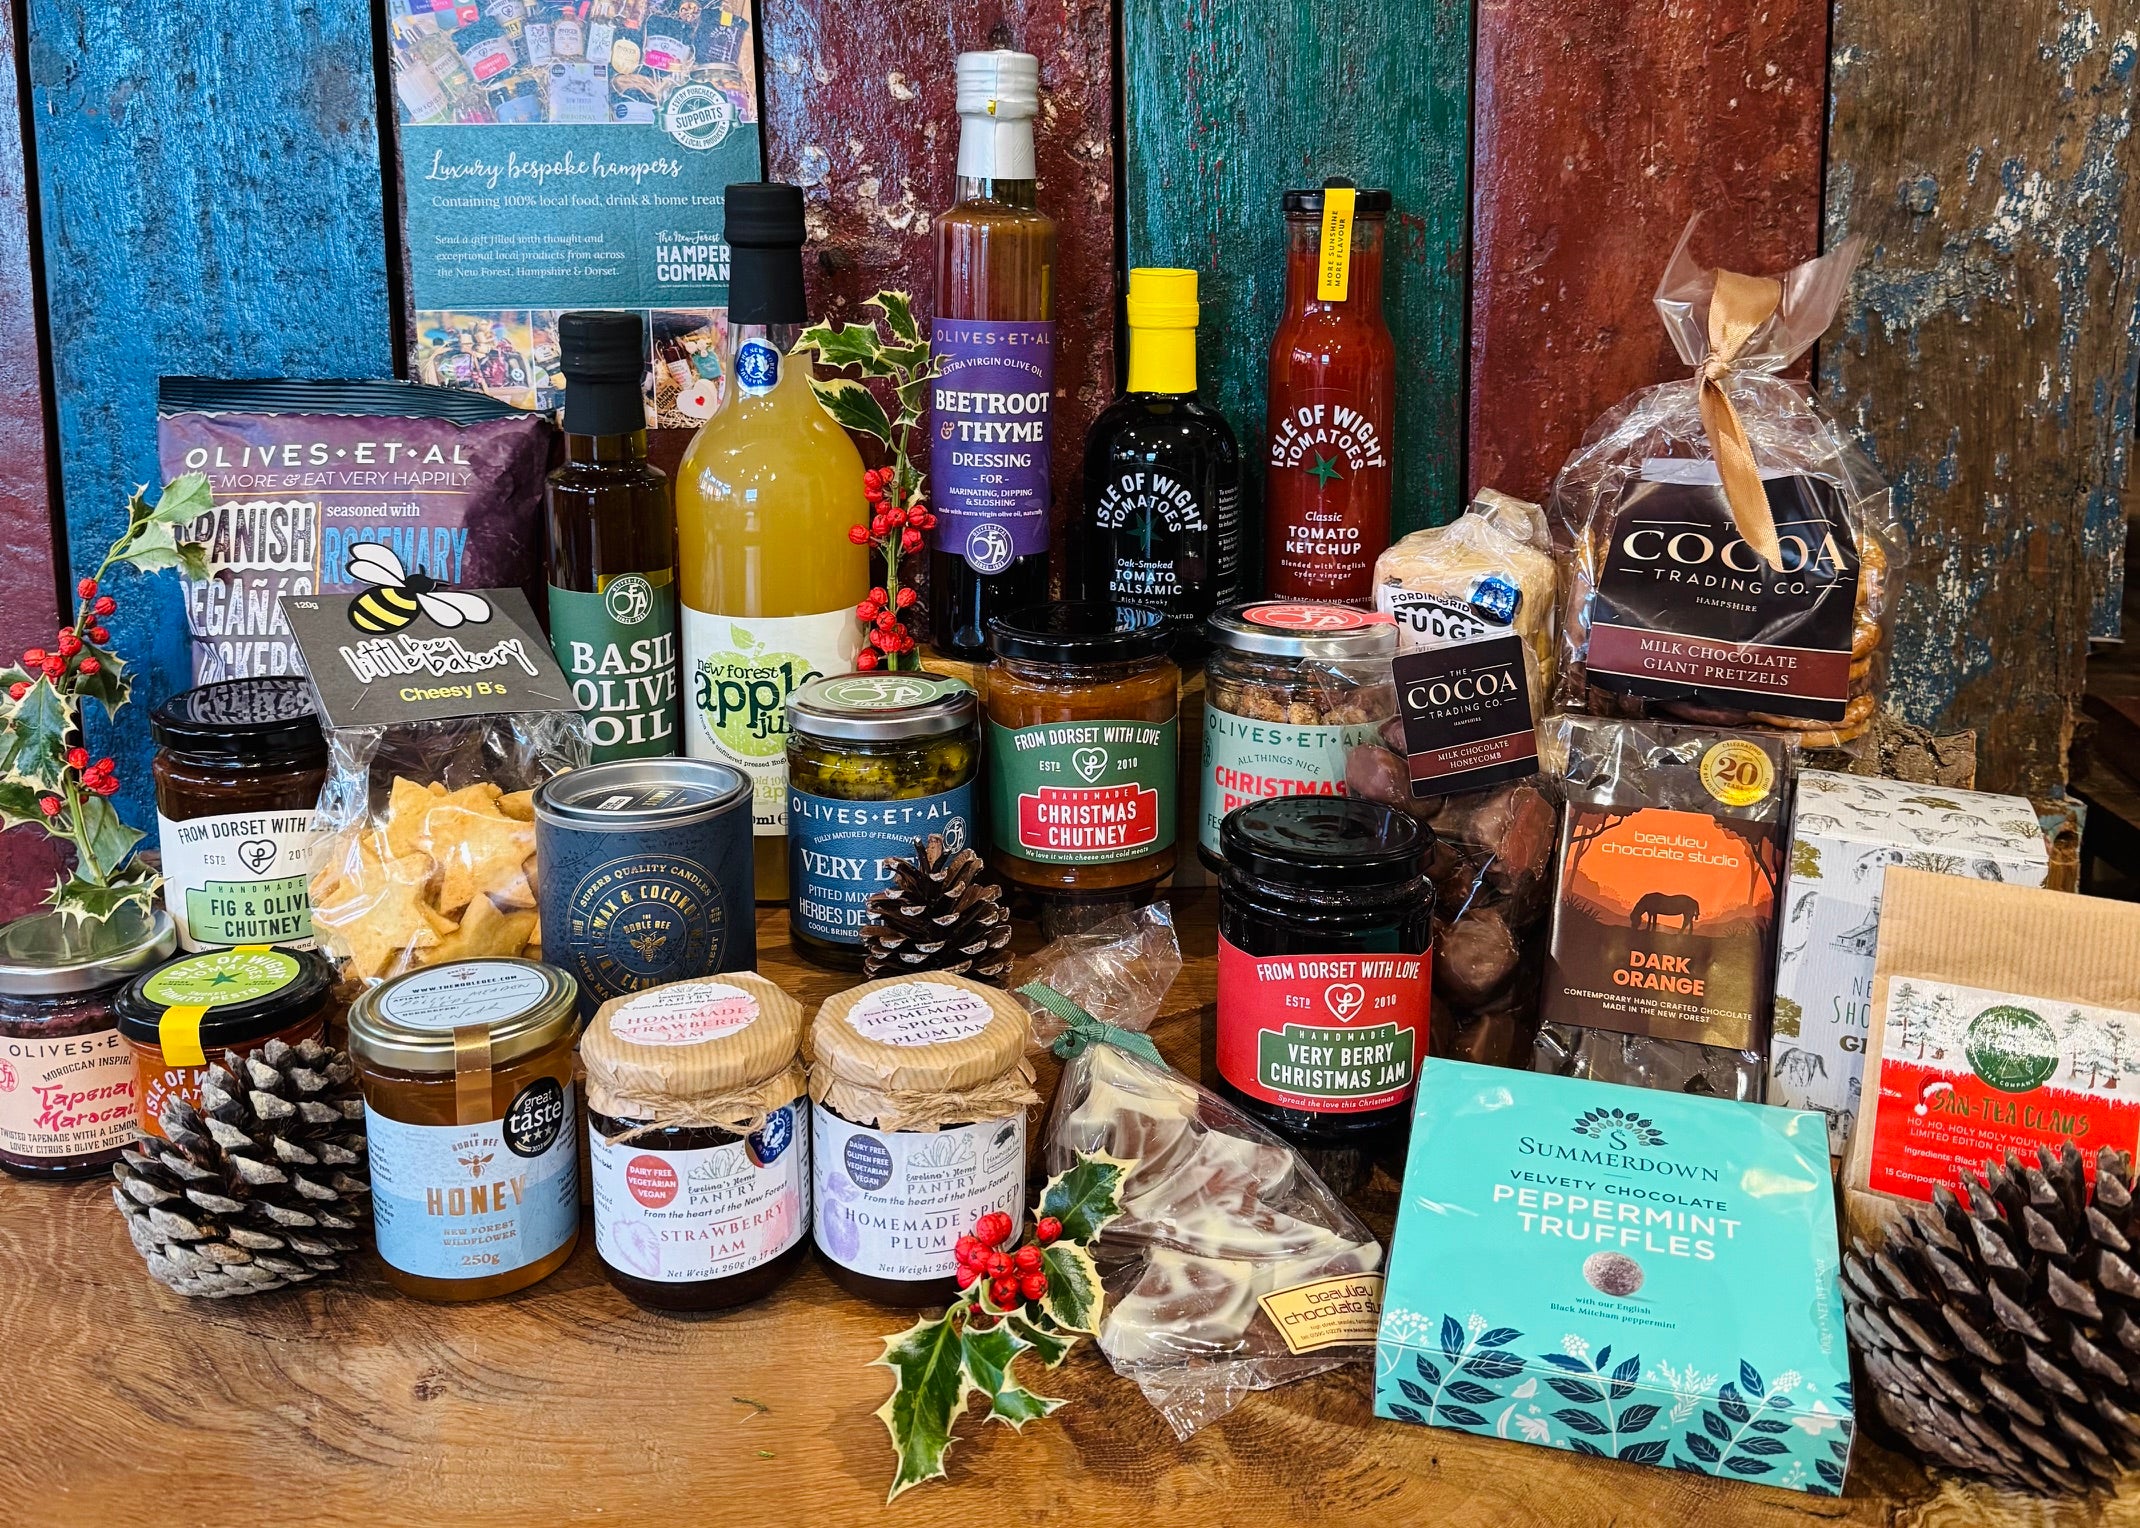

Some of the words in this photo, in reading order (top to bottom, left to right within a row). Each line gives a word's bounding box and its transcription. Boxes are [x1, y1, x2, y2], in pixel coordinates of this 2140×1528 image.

[676, 107, 723, 129] SUPPORTS
[426, 150, 504, 189] Luxury
[508, 151, 589, 185] bespoke
[592, 152, 682, 184] hampers
[432, 196, 500, 208] Containing
[504, 196, 536, 206] 100%
[540, 194, 570, 206] local
[572, 194, 603, 207] food,
[606, 194, 638, 206] drink
[642, 195, 650, 206] &
[654, 194, 688, 206] home
[692, 196, 725, 205] treats
[1329, 210, 1338, 257] SUNSHINE
[1337, 218, 1346, 258] FLAVOUR
[436, 251, 492, 261] exceptional
[496, 251, 519, 260] local
[522, 251, 564, 262] products
[567, 250, 592, 260] from
[595, 251, 625, 259] across
[657, 246, 731, 262] HAMPER
[658, 264, 731, 281] COMPAN
[936, 390, 1049, 415] BEETROOT
[940, 421, 954, 441] &
[958, 421, 1043, 442] THYME
[952, 452, 1031, 468] DRESSING
[221, 473, 277, 489] MORE
[283, 472, 301, 487] &
[304, 472, 334, 485] EAT
[340, 471, 390, 486] VERY
[394, 472, 472, 486] HAPPILY
[950, 487, 1000, 498] MARINATING,
[1001, 489, 1032, 497] DIPPING
[327, 505, 388, 517] seasoned
[390, 502, 420, 517] with
[1305, 511, 1343, 522] Classic
[1289, 525, 1359, 539] TOMATO
[1286, 541, 1361, 555] KETCHUP
[1622, 530, 1849, 574] COCOA
[1117, 558, 1173, 569] Oak-Smoked
[1281, 560, 1311, 568] Blended
[1336, 562, 1366, 571] English
[1115, 569, 1176, 582] TOMATO
[1110, 582, 1183, 595] BALSAMIC
[294, 602, 319, 611] 120g
[570, 632, 675, 675] BASIL
[1639, 638, 1683, 656] MILK
[1687, 644, 1798, 669] CHOCOLATE
[697, 659, 725, 677] new
[727, 665, 779, 679] forest
[1643, 657, 1700, 675] GIANT
[1704, 666, 1789, 686] PRETZELS
[400, 684, 472, 702] Cheesy
[572, 666, 676, 713] OLIVE
[1407, 670, 1518, 710] COCOA
[586, 708, 673, 747] OIL
[1014, 731, 1046, 751] FROM
[1049, 727, 1100, 746] DORSET
[1103, 727, 1133, 743] WITH
[1135, 728, 1161, 746] LOVE
[1438, 750, 1458, 761] MILK
[1460, 739, 1510, 757] CHOCOLATE
[1450, 752, 1502, 769] HONEYCOMB
[1237, 755, 1253, 766] ALL
[1255, 754, 1293, 766] THINGS
[1295, 759, 1321, 775] NICE
[1715, 757, 1758, 785] 20
[1037, 800, 1137, 824] CHRISTMAS
[177, 822, 209, 844] FROM
[213, 819, 265, 839] DORSET
[270, 817, 307, 834] WITH
[1048, 824, 1127, 847] CHUTNEY
[1634, 830, 1708, 850] beaulieu
[800, 847, 870, 881] VERY
[1025, 848, 1035, 858] We
[1036, 850, 1049, 859] love
[1050, 852, 1057, 860] it
[1100, 851, 1114, 860] and
[1115, 849, 1130, 858] cold
[1131, 846, 1149, 856] meats
[1601, 841, 1685, 862] chocolate
[1688, 850, 1739, 868] studio
[580, 875, 612, 907] SUPERB
[614, 864, 667, 879] QUALITY
[671, 867, 711, 896] CANDLES
[808, 883, 843, 901] PITTED
[210, 897, 237, 917] FIG
[244, 901, 256, 916] &
[799, 896, 844, 926] HERBES
[846, 908, 865, 926] DE
[225, 915, 302, 938] CHUTNEY
[1629, 950, 1691, 974] DARK
[1612, 969, 1705, 997] ORANGE
[1563, 987, 1632, 1005] CONTEMPORARY
[1634, 997, 1658, 1007] HAND
[1660, 1000, 1698, 1013] CRAFTED
[1700, 1006, 1752, 1022] CHOCOLATE
[898, 1014, 969, 1032] SPICED
[1288, 1043, 1334, 1066] VERY
[1340, 1041, 1395, 1067] BERRY
[1270, 1063, 1371, 1090] CHRISTMAS
[1376, 1062, 1406, 1087] JAM
[524, 1089, 553, 1112] great
[509, 1100, 562, 1133] taste
[1932, 1089, 2016, 1127] SAN-TEA
[2024, 1106, 2090, 1137] CLAUS
[0, 1127, 26, 1142] TWISTED
[27, 1130, 70, 1143] TAPENADE
[72, 1128, 97, 1141] WITH
[100, 1128, 106, 1137] A
[108, 1118, 138, 1136] LEMON
[1910, 1128, 1950, 1143] LIMITED
[1952, 1136, 1993, 1150] EDITION
[1518, 1135, 1720, 1183] SUMMERDOWN
[1904, 1145, 1953, 1162] Ingredients:
[1954, 1154, 1978, 1167] Black
[628, 1177, 676, 1188] VEGETARIAN
[629, 1167, 653, 1177] DAIRY
[654, 1168, 673, 1177] FREE
[427, 1174, 527, 1216] HONEY
[637, 1189, 667, 1199] VEGAN
[689, 1181, 757, 1205] PANTRY
[907, 1175, 977, 1194] PANTRY
[1510, 1169, 1596, 1191] VELVETY
[1604, 1184, 1729, 1212] CHOCOLATE
[643, 1210, 667, 1220] From
[669, 1211, 684, 1219] the
[686, 1209, 713, 1219] heart
[715, 1206, 726, 1215] of
[727, 1203, 743, 1212] the
[744, 1194, 763, 1207] New
[765, 1180, 789, 1199] Forest
[845, 1207, 961, 1231] HOMEMADE
[969, 1182, 1020, 1220] SPICED
[1492, 1183, 1742, 1239] PEPPERMINT
[660, 1201, 784, 1242] STRAWBERRY
[443, 1230, 517, 1246] WILDFLOWER
[891, 1236, 947, 1249] PLUM
[1516, 1212, 1716, 1261] TRUFFLES
[461, 1253, 500, 1266] 250g
[709, 1239, 746, 1259] JAM
[1305, 1284, 1373, 1304] beaulieu
[1550, 1302, 1576, 1314] Black
[1578, 1306, 1619, 1322] Mitcham
[1621, 1312, 1676, 1330] peppermint
